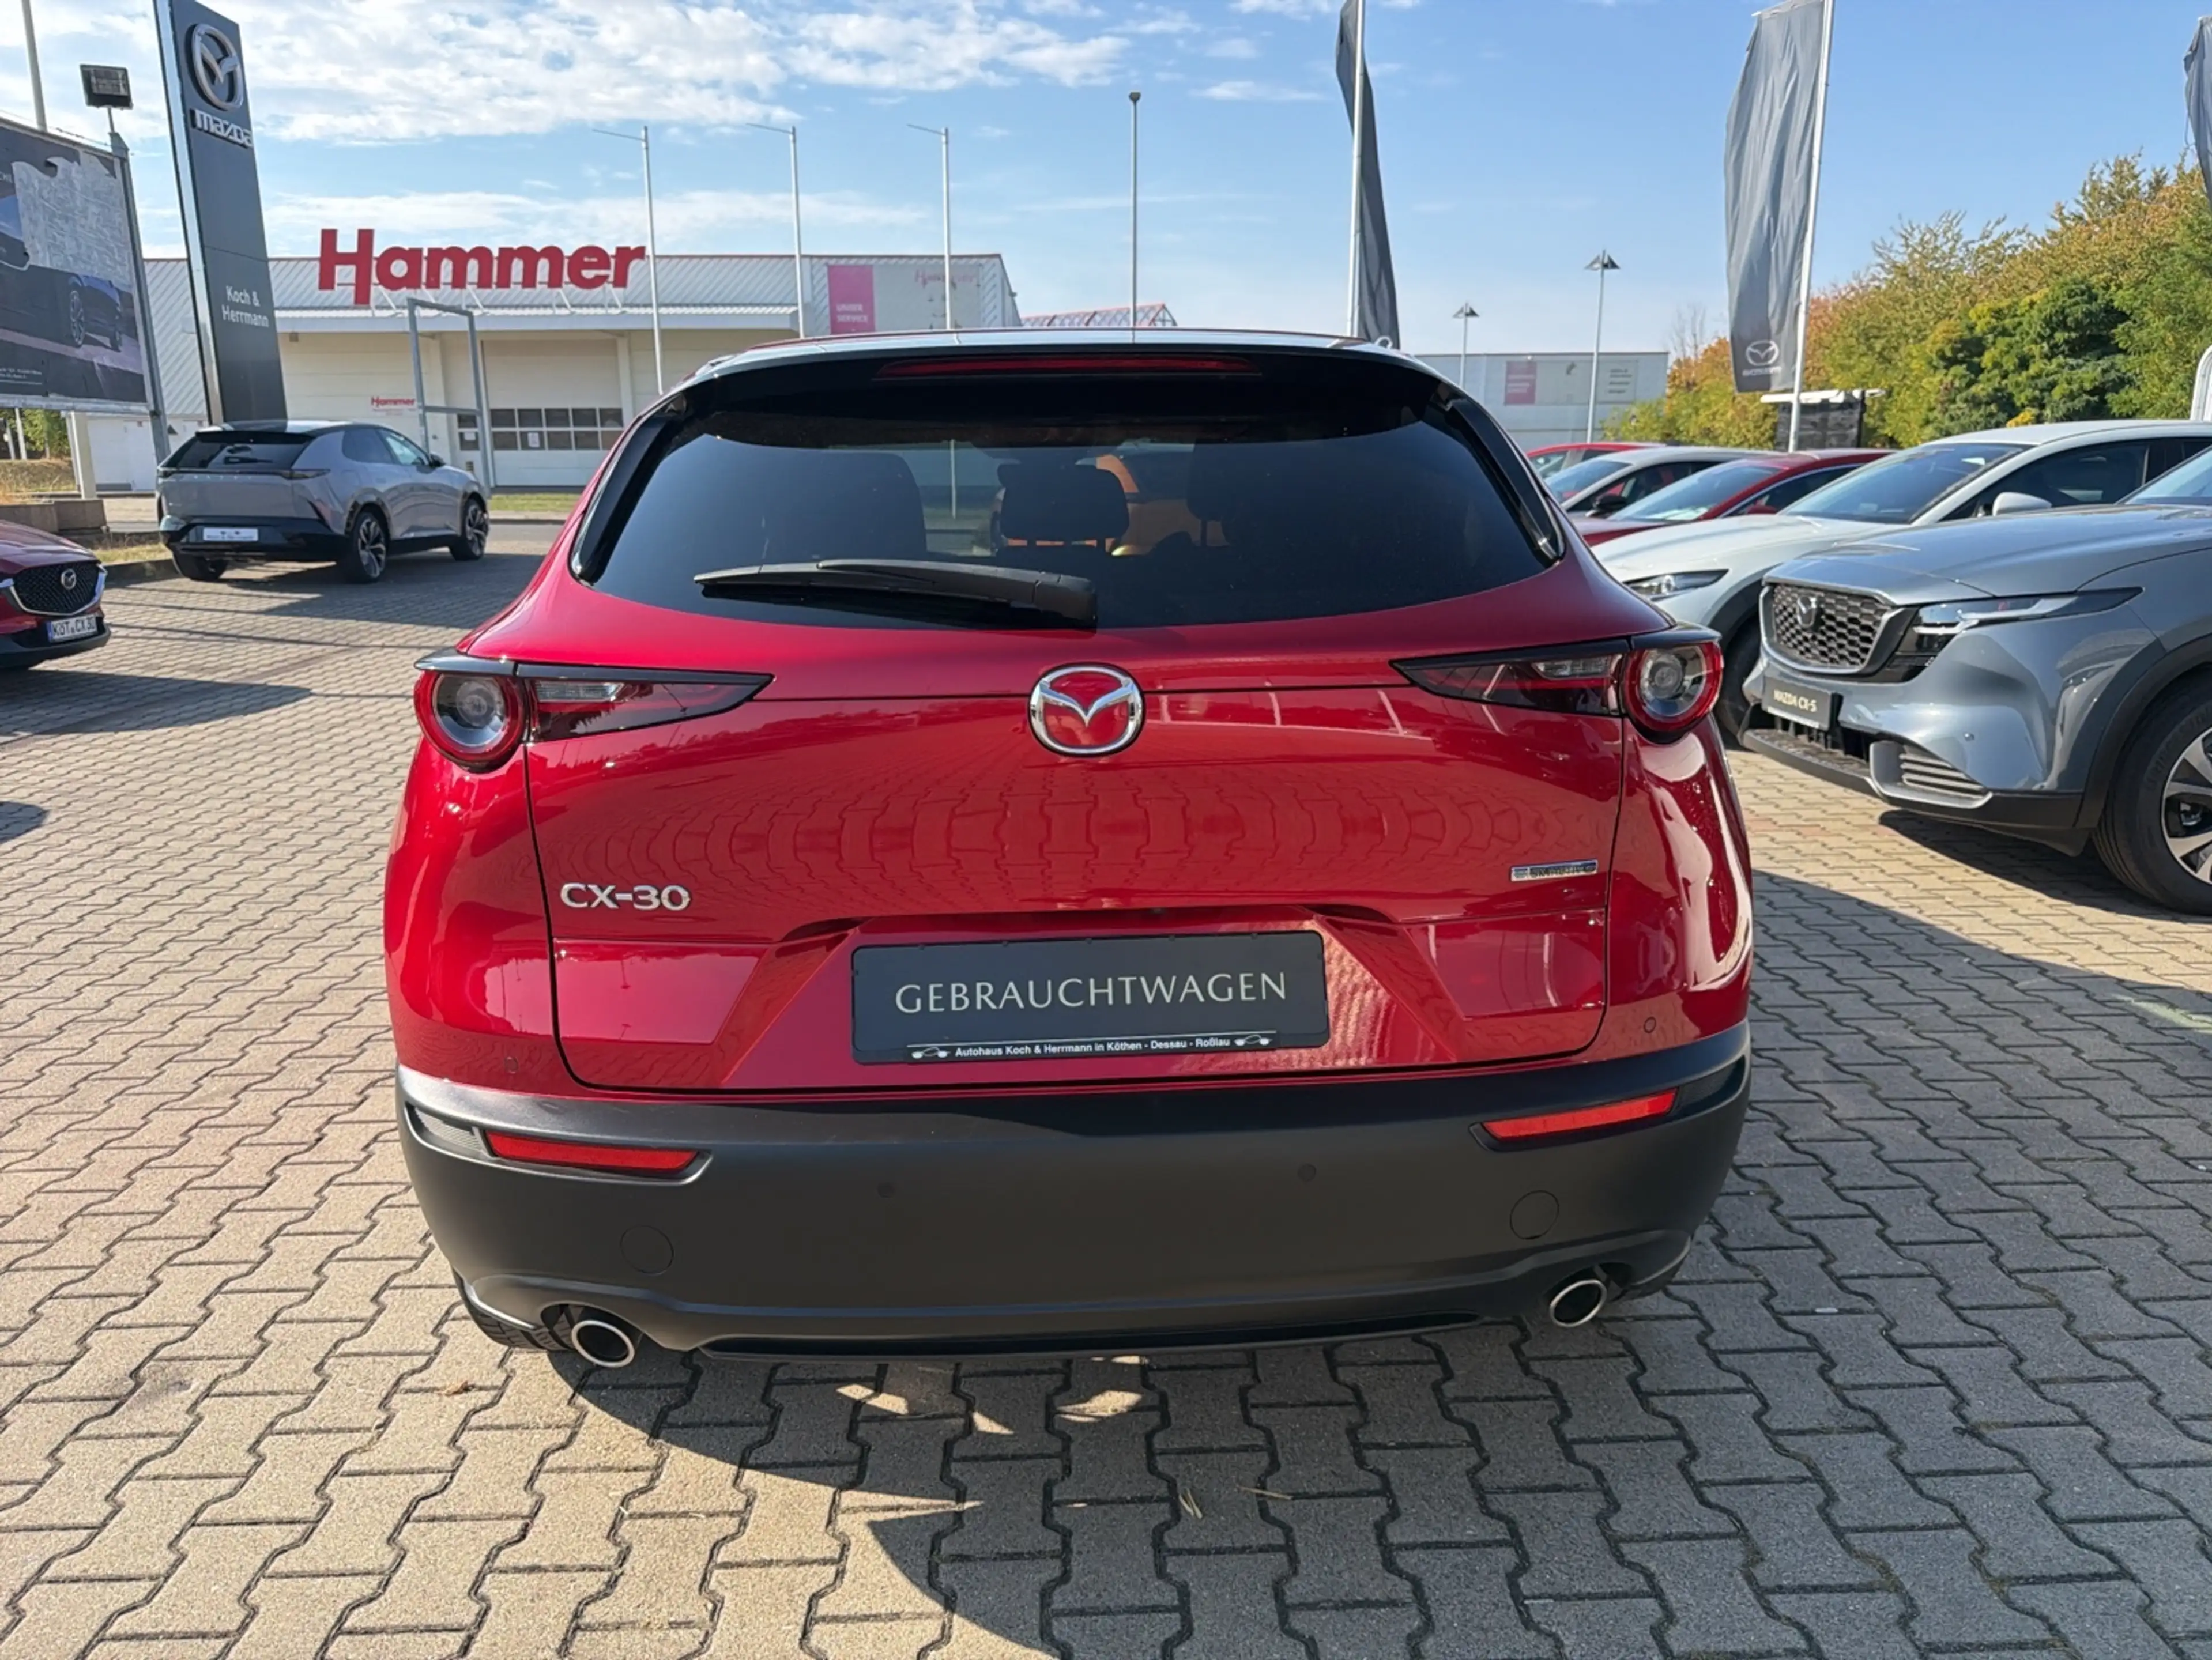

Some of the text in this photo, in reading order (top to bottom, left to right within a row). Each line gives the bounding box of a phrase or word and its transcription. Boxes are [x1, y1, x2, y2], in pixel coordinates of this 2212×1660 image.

[194, 108, 254, 147] mazda
[319, 229, 646, 305] Hammer
[225, 285, 251, 305] Koch
[221, 304, 270, 328] Herrmann
[1773, 689, 1798, 708] MAZDA
[560, 882, 691, 911] CX-30
[895, 972, 1286, 1013] GEBRAUCHTWAGEN
[955, 1047, 1003, 1057] Autohaus
[1005, 1045, 1031, 1055] Koch
[1033, 1044, 1041, 1054] &
[1043, 1043, 1092, 1053] Herrmann
[1094, 1042, 1105, 1051] in
[1107, 1041, 1142, 1051] Köthen
[1151, 1040, 1187, 1050] Dessau
[1196, 1037, 1230, 1047] Roßlau
